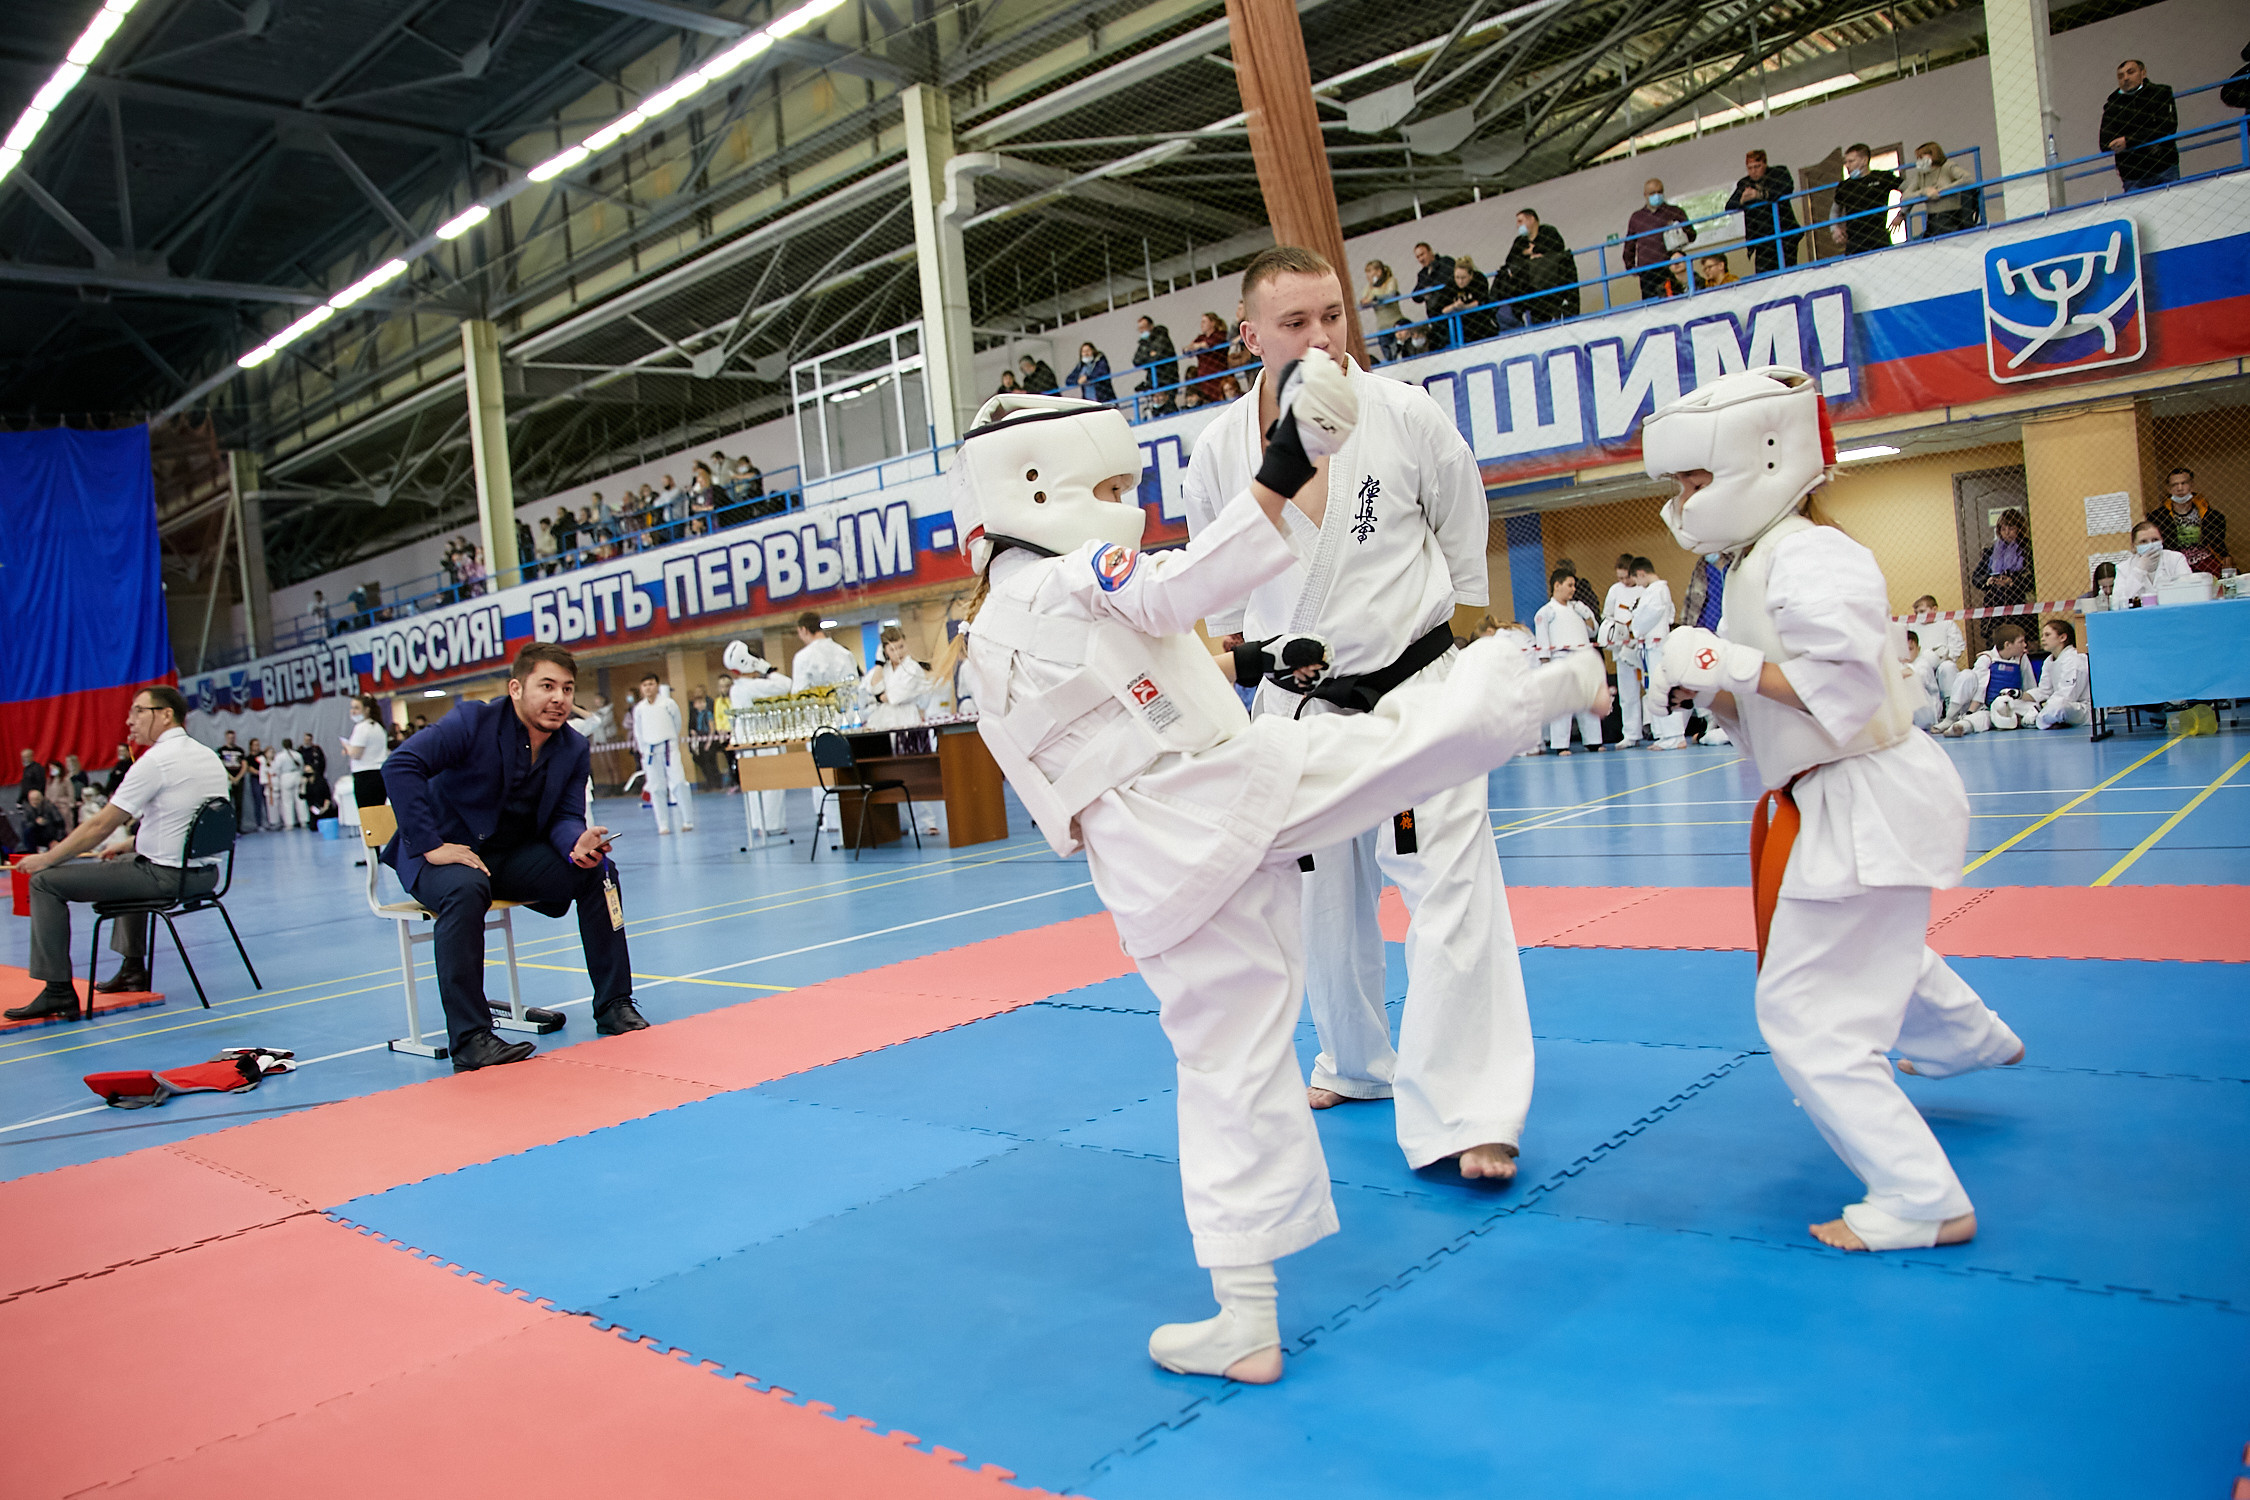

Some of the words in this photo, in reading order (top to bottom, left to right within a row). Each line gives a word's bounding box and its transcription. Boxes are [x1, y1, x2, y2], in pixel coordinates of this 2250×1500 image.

[370, 605, 504, 683] РОССИЯ!
[531, 571, 653, 644] БЫТЬ
[663, 501, 914, 620] ПЕРВЫМ
